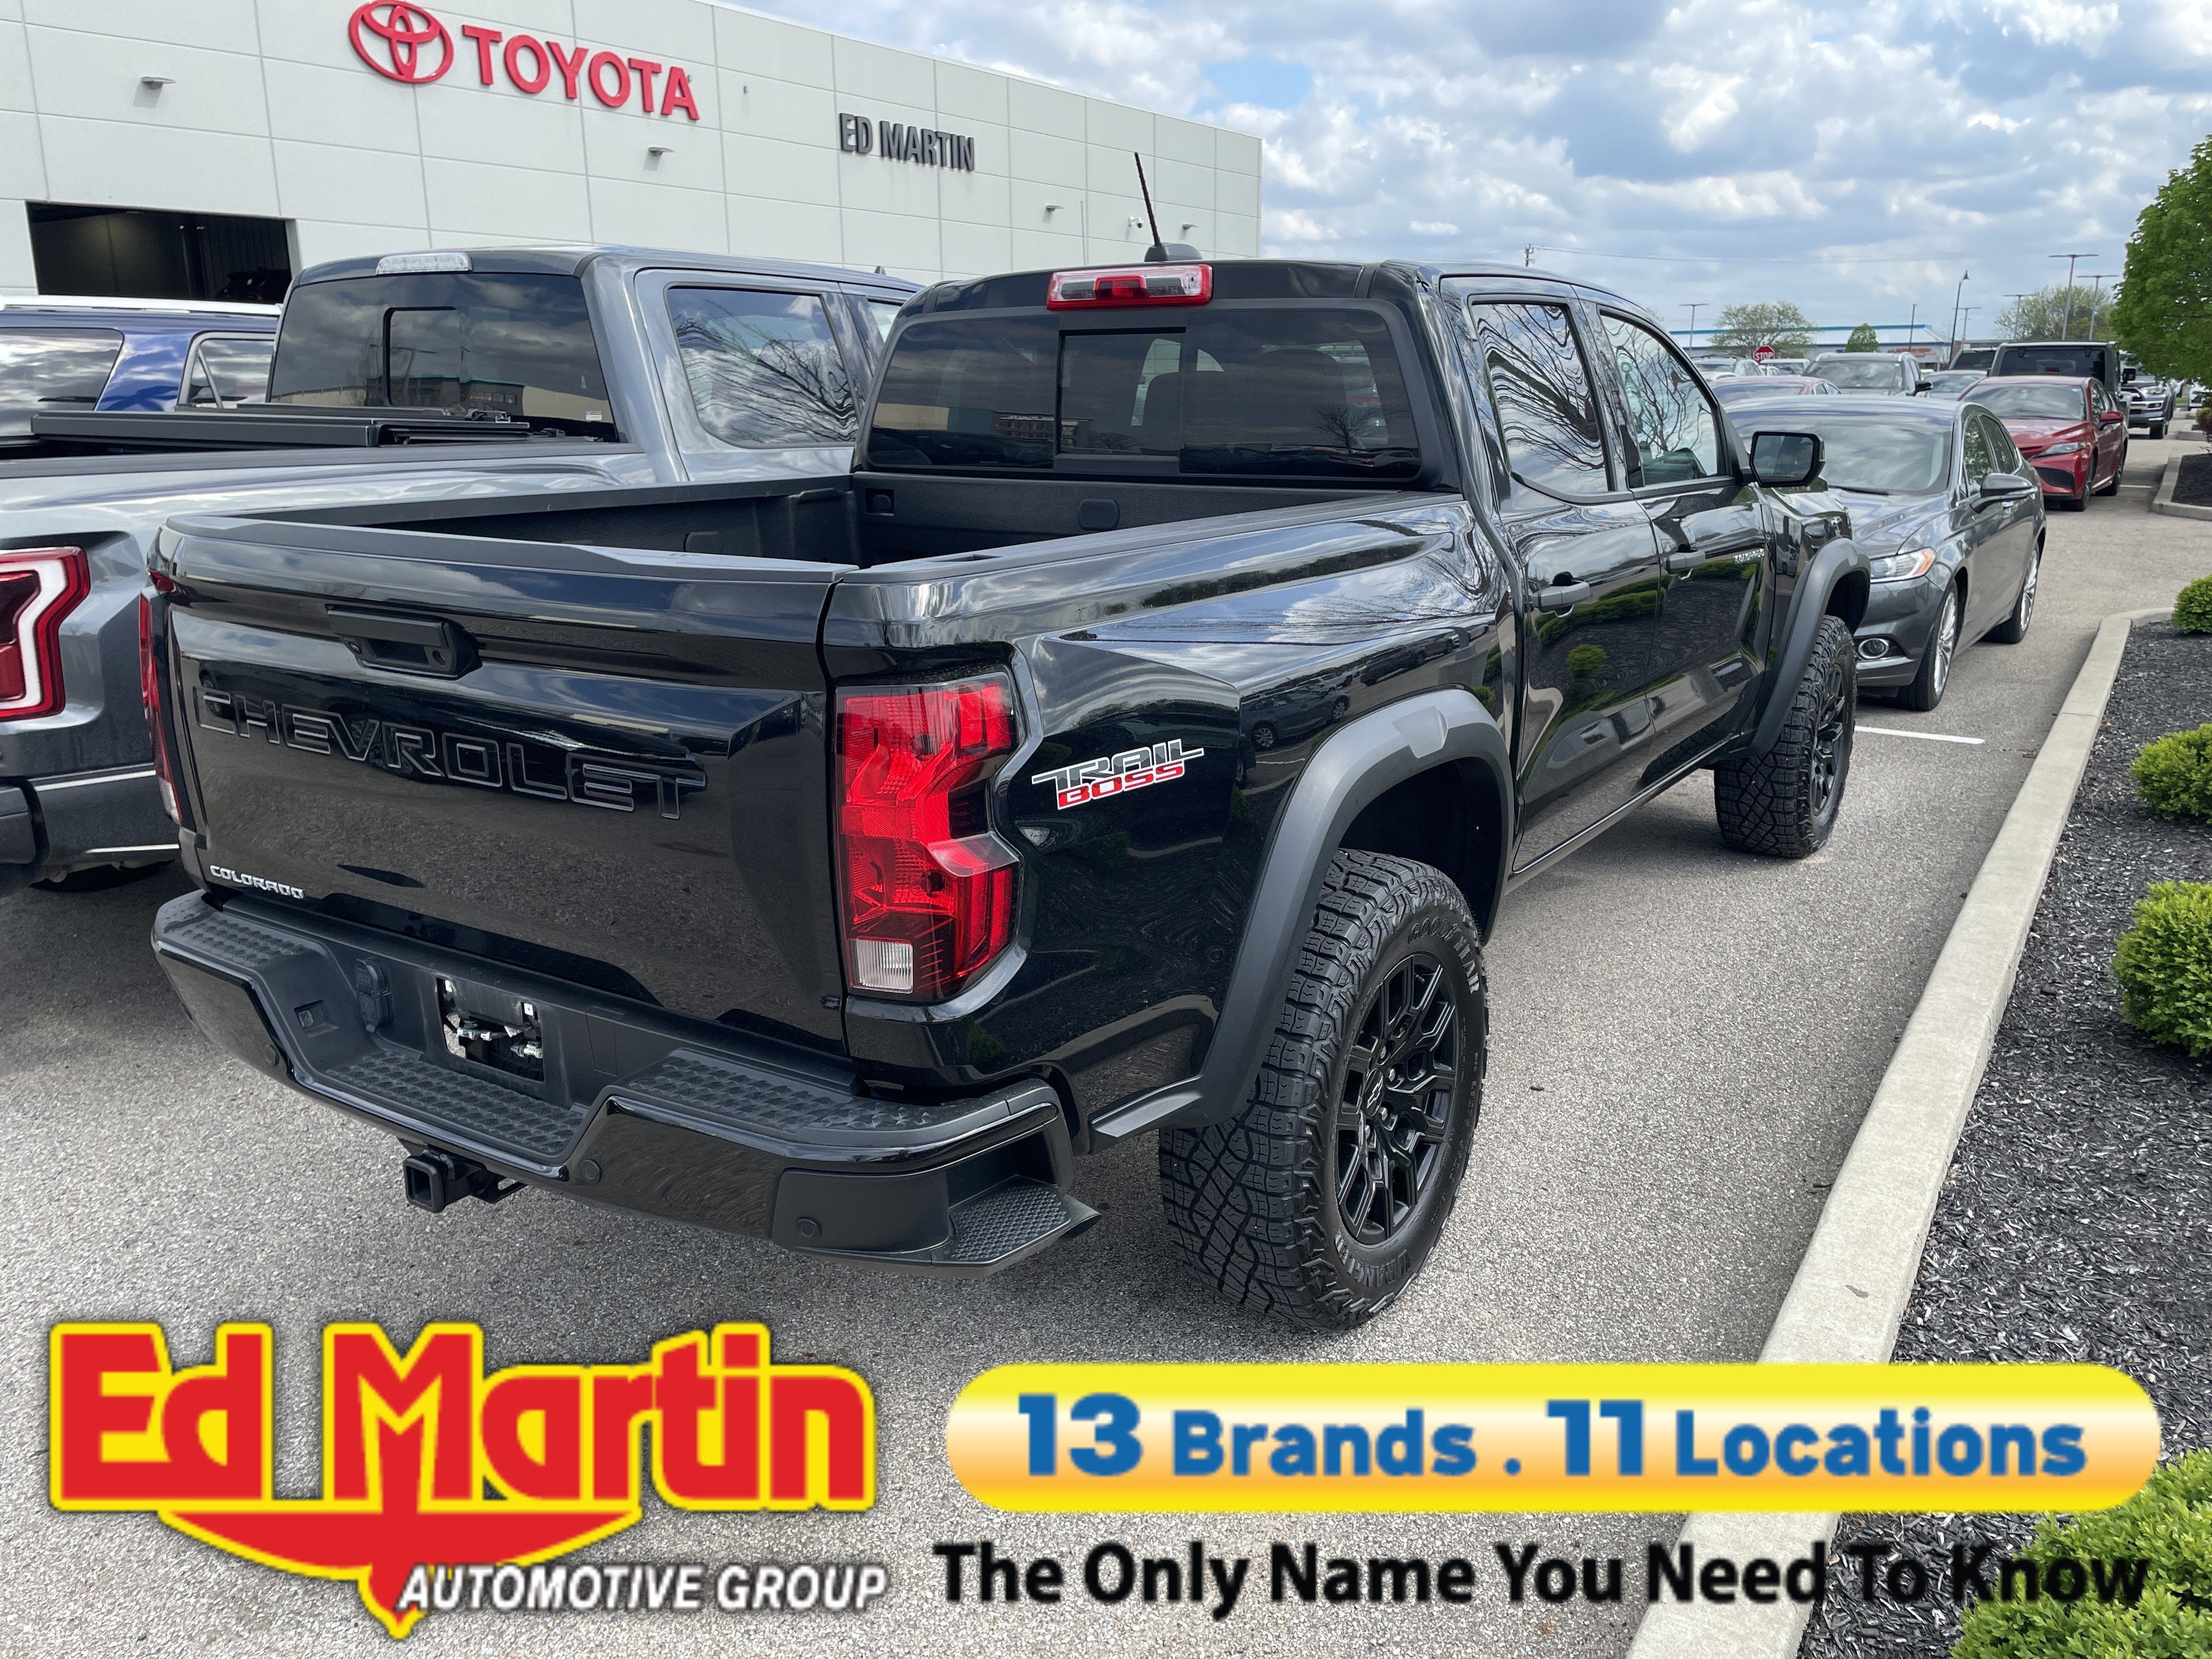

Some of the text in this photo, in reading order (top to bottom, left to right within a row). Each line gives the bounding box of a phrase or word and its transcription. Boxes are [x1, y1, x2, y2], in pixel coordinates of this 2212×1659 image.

[462, 24, 699, 121] TOYOTA
[839, 112, 975, 171] ED MARTIN
[1755, 352, 1774, 361] STOP
[193, 685, 707, 819] CHEVROLET
[1031, 738, 1204, 792] TRAIL
[1057, 759, 1185, 810] BOSS
[210, 865, 305, 900] COLORADO
[1407, 916, 1480, 995] GOODYEAR
